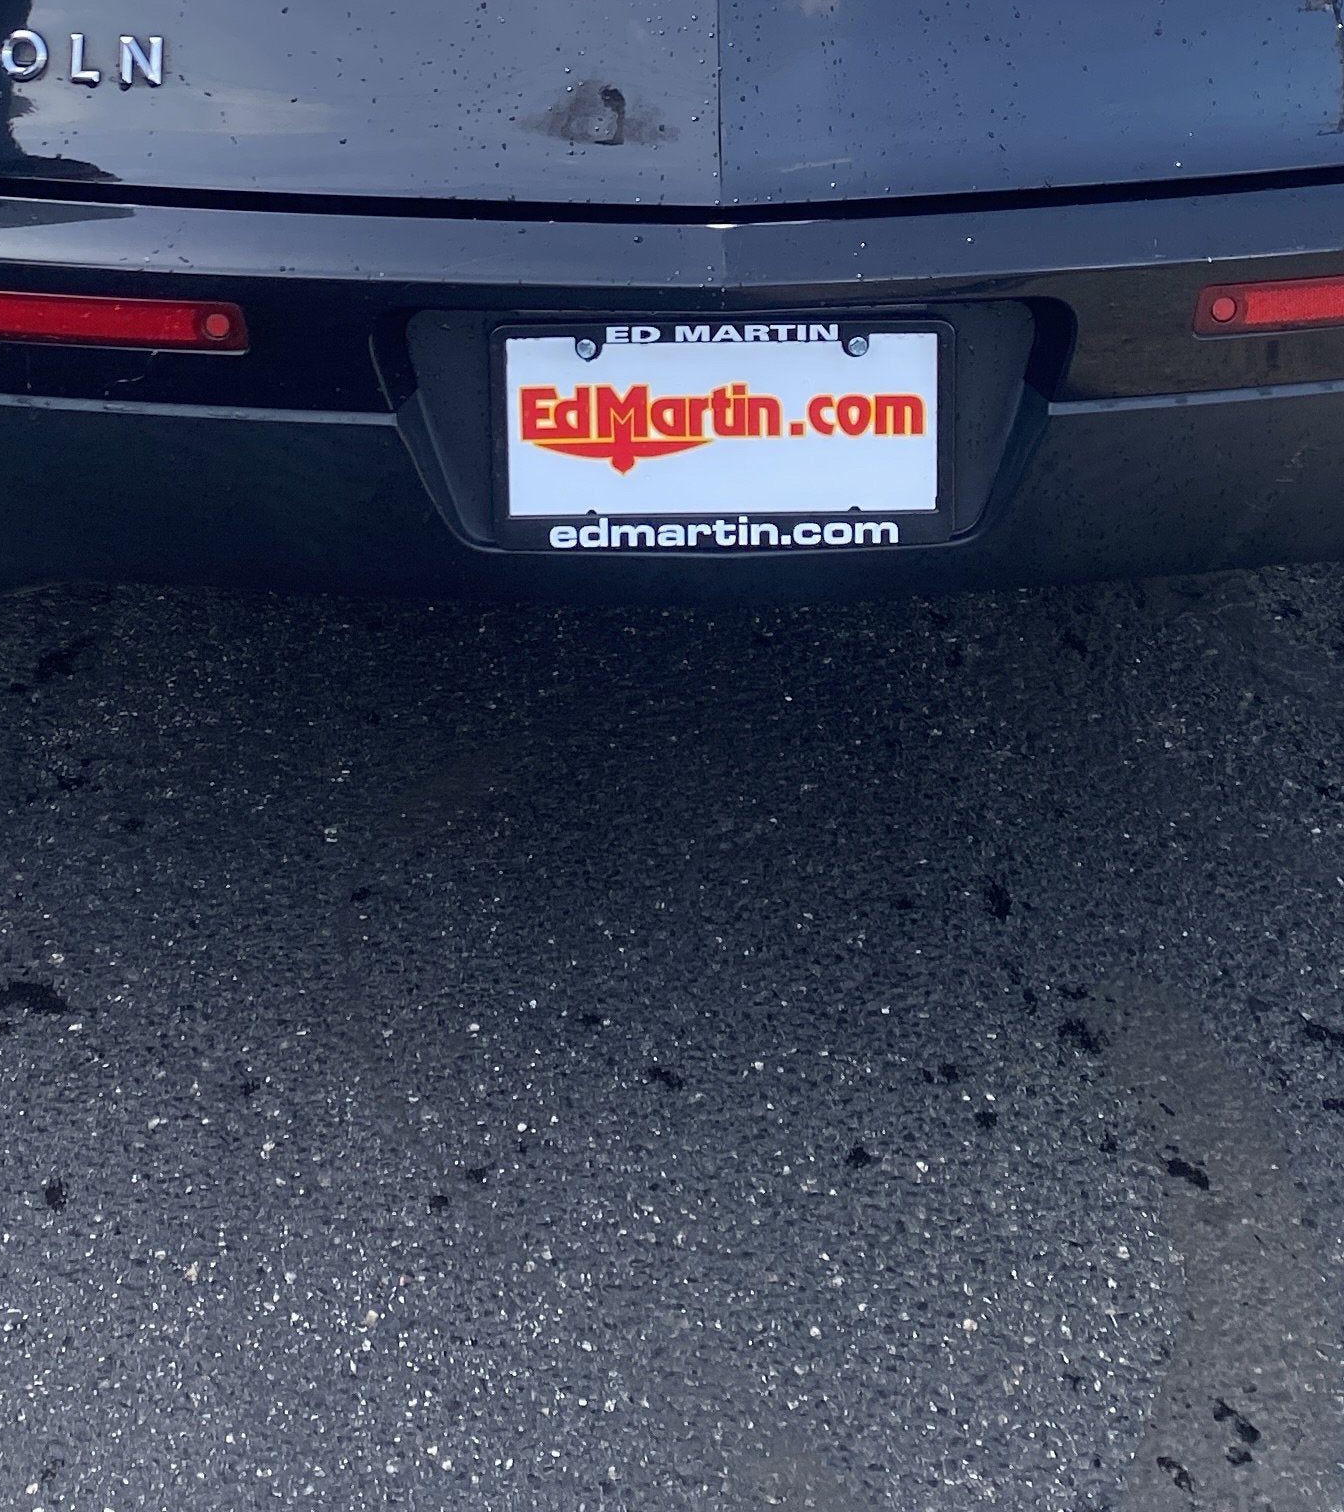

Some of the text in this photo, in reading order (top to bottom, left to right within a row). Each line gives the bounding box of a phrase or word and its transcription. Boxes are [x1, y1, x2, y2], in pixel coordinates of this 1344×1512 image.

[605, 323, 839, 343] ED MARTIN
[549, 517, 900, 549] edmartin.com
